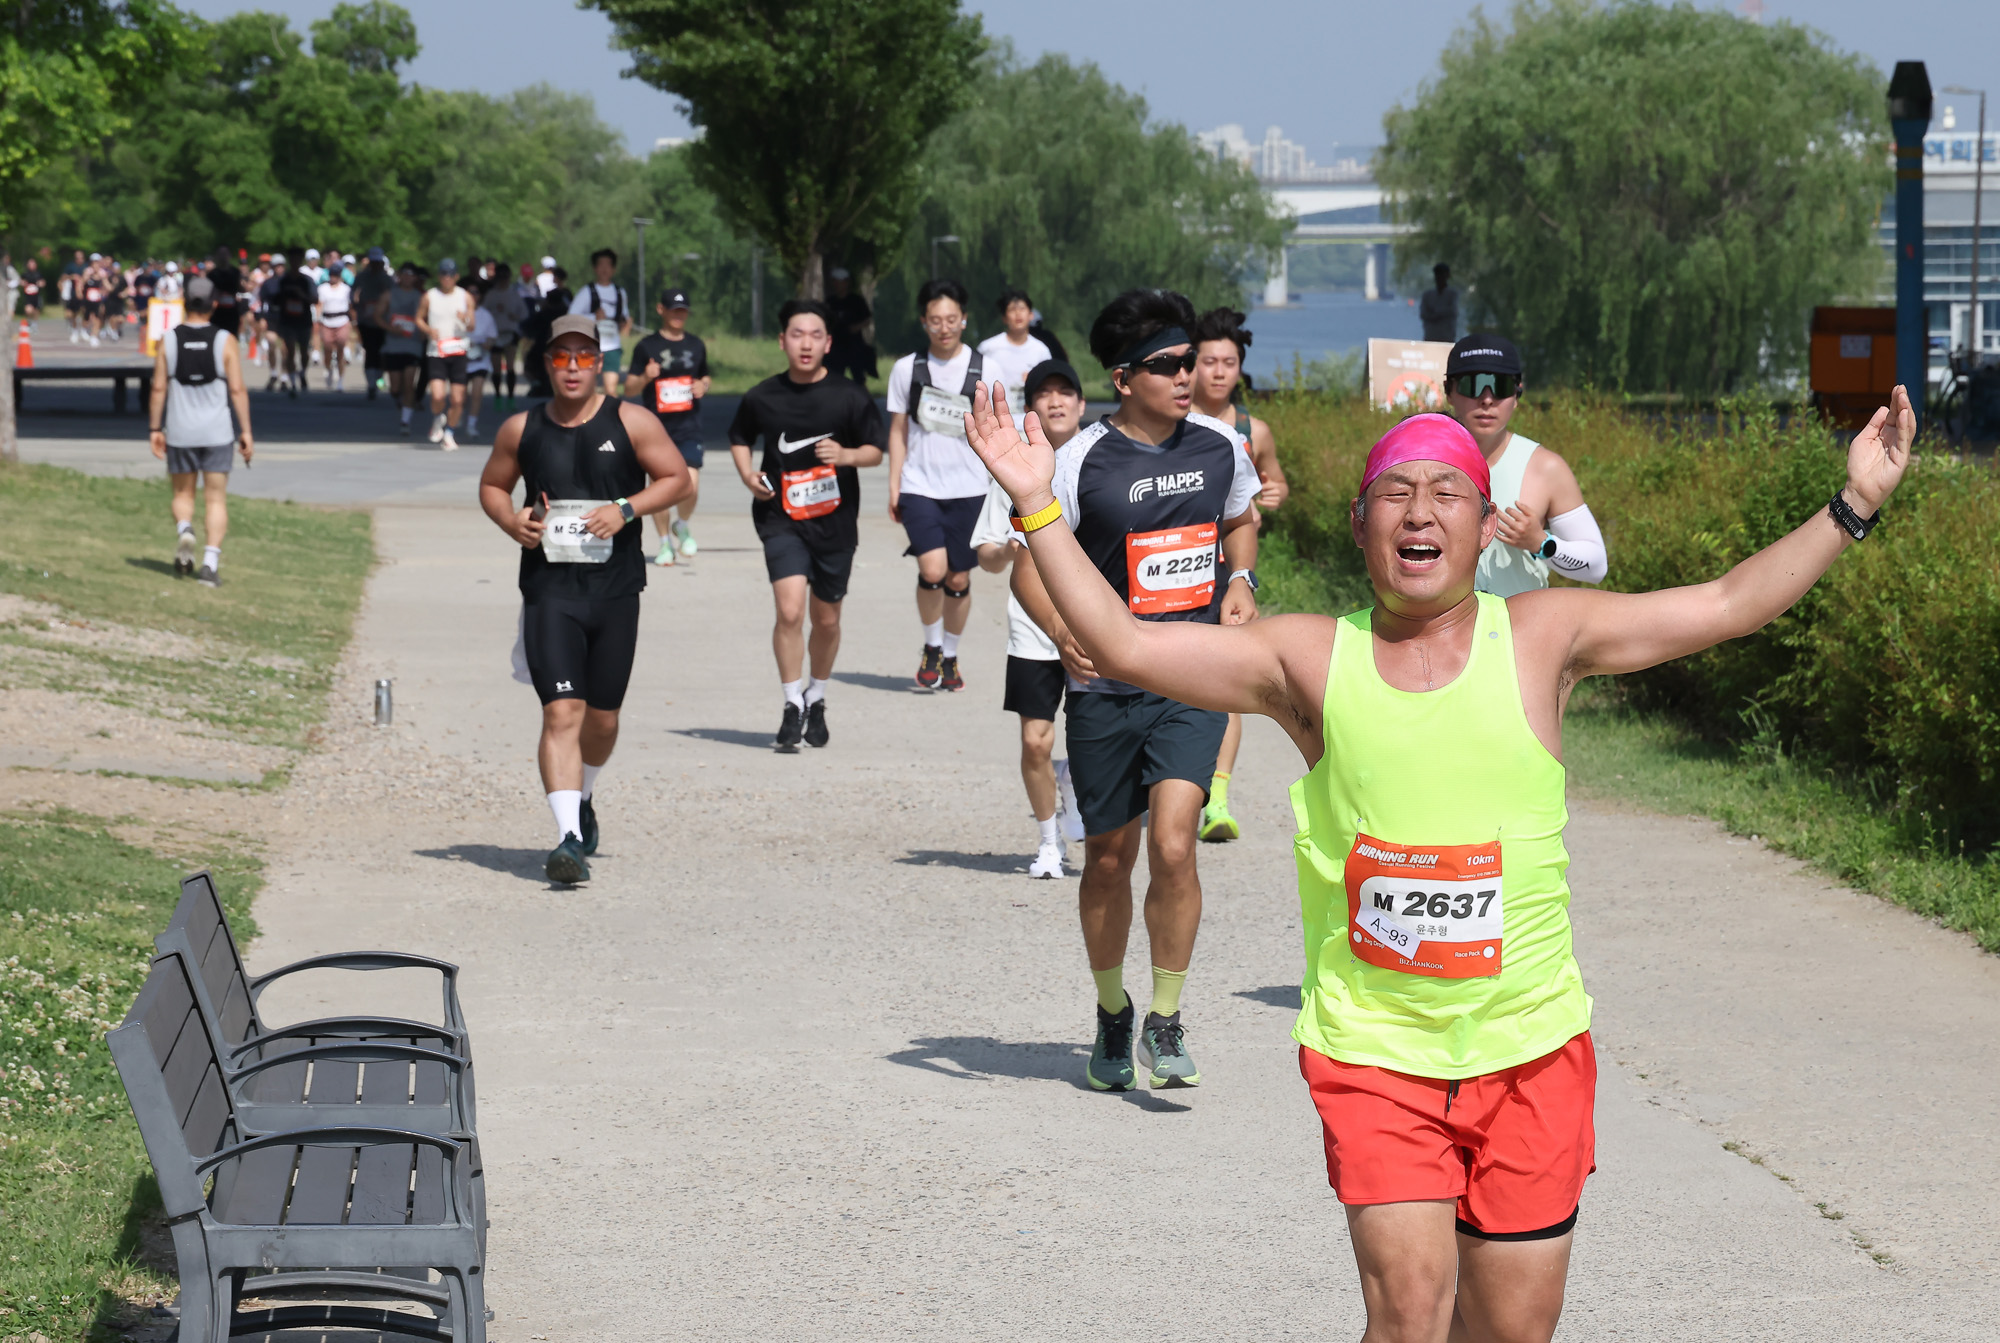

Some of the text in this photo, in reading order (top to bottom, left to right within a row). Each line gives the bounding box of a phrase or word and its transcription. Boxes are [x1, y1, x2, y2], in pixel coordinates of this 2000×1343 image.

[1155, 470, 1204, 491] HAPPS
[554, 525, 563, 534] M
[1131, 536, 1164, 547] BURNING
[1147, 552, 1213, 577] M 2225
[1356, 843, 1439, 864] BURNING RUN
[1466, 855, 1495, 866] 10km
[1373, 890, 1496, 919] M 2637
[1370, 917, 1409, 947] A-93
[1416, 924, 1447, 937] 윤주형
[1364, 937, 1385, 949] Bag Drop
